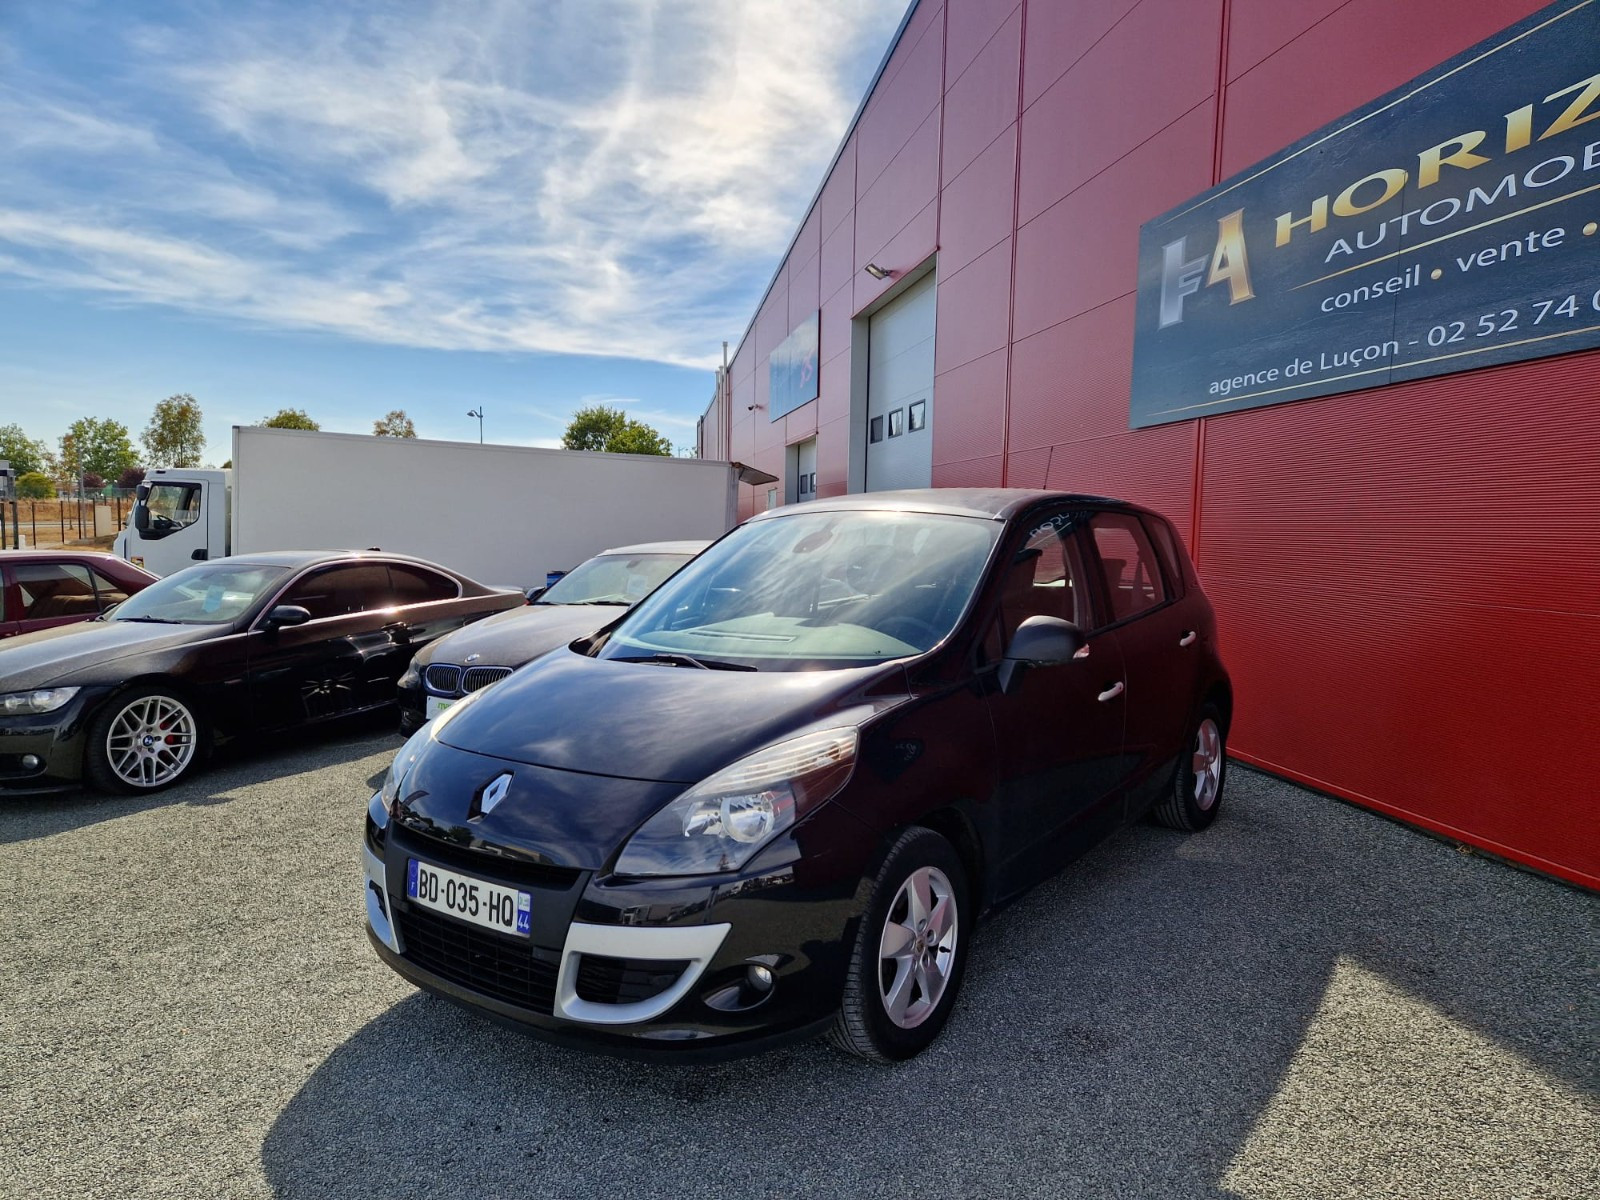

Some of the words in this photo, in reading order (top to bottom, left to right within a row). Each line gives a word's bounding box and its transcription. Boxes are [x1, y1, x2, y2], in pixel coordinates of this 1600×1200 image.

[1275, 73, 1600, 248] HORIZ
[1321, 264, 1420, 312] conseil
[1456, 227, 1565, 272] vente
[1209, 367, 1280, 396] agence
[1285, 358, 1313, 378] de
[1320, 340, 1399, 368] Luçon
[1427, 321, 1466, 347] 02
[1476, 309, 1518, 337] 52
[1532, 294, 1580, 325] 74
[418, 868, 514, 928] BD-035-HQ
[518, 913, 530, 930] 44
